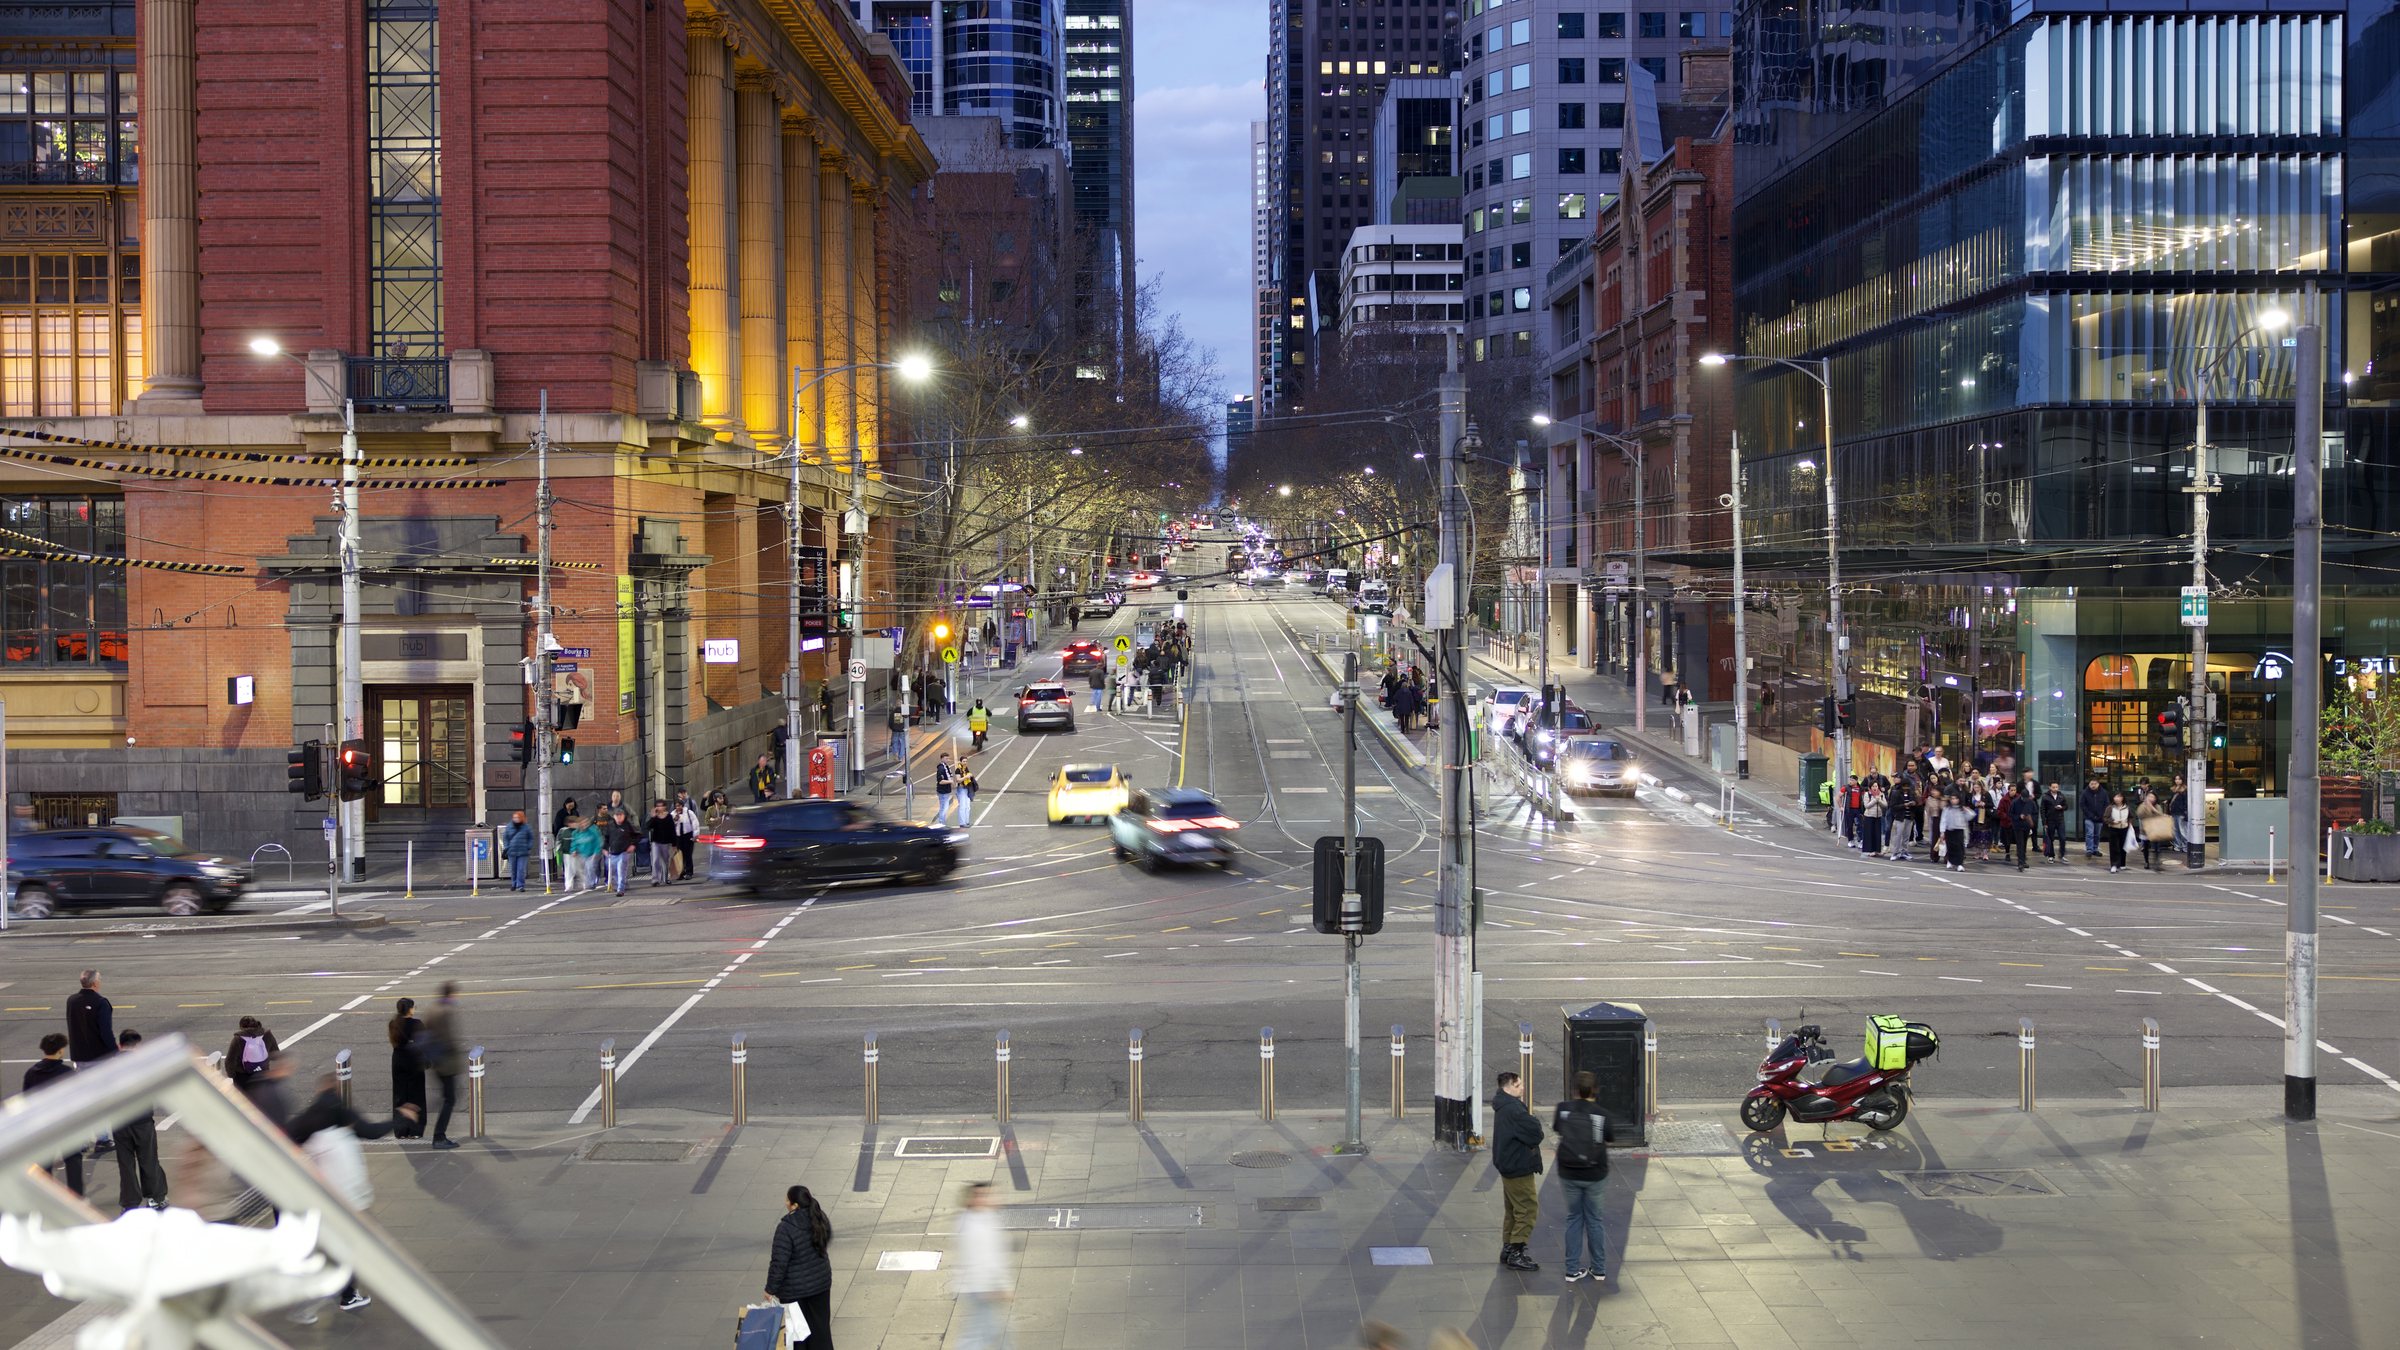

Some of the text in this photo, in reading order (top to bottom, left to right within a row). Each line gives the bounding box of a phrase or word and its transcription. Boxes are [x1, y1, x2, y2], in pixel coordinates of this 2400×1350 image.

[402, 638, 423, 650] hub
[708, 644, 734, 656] hub
[852, 666, 863, 675] 40
